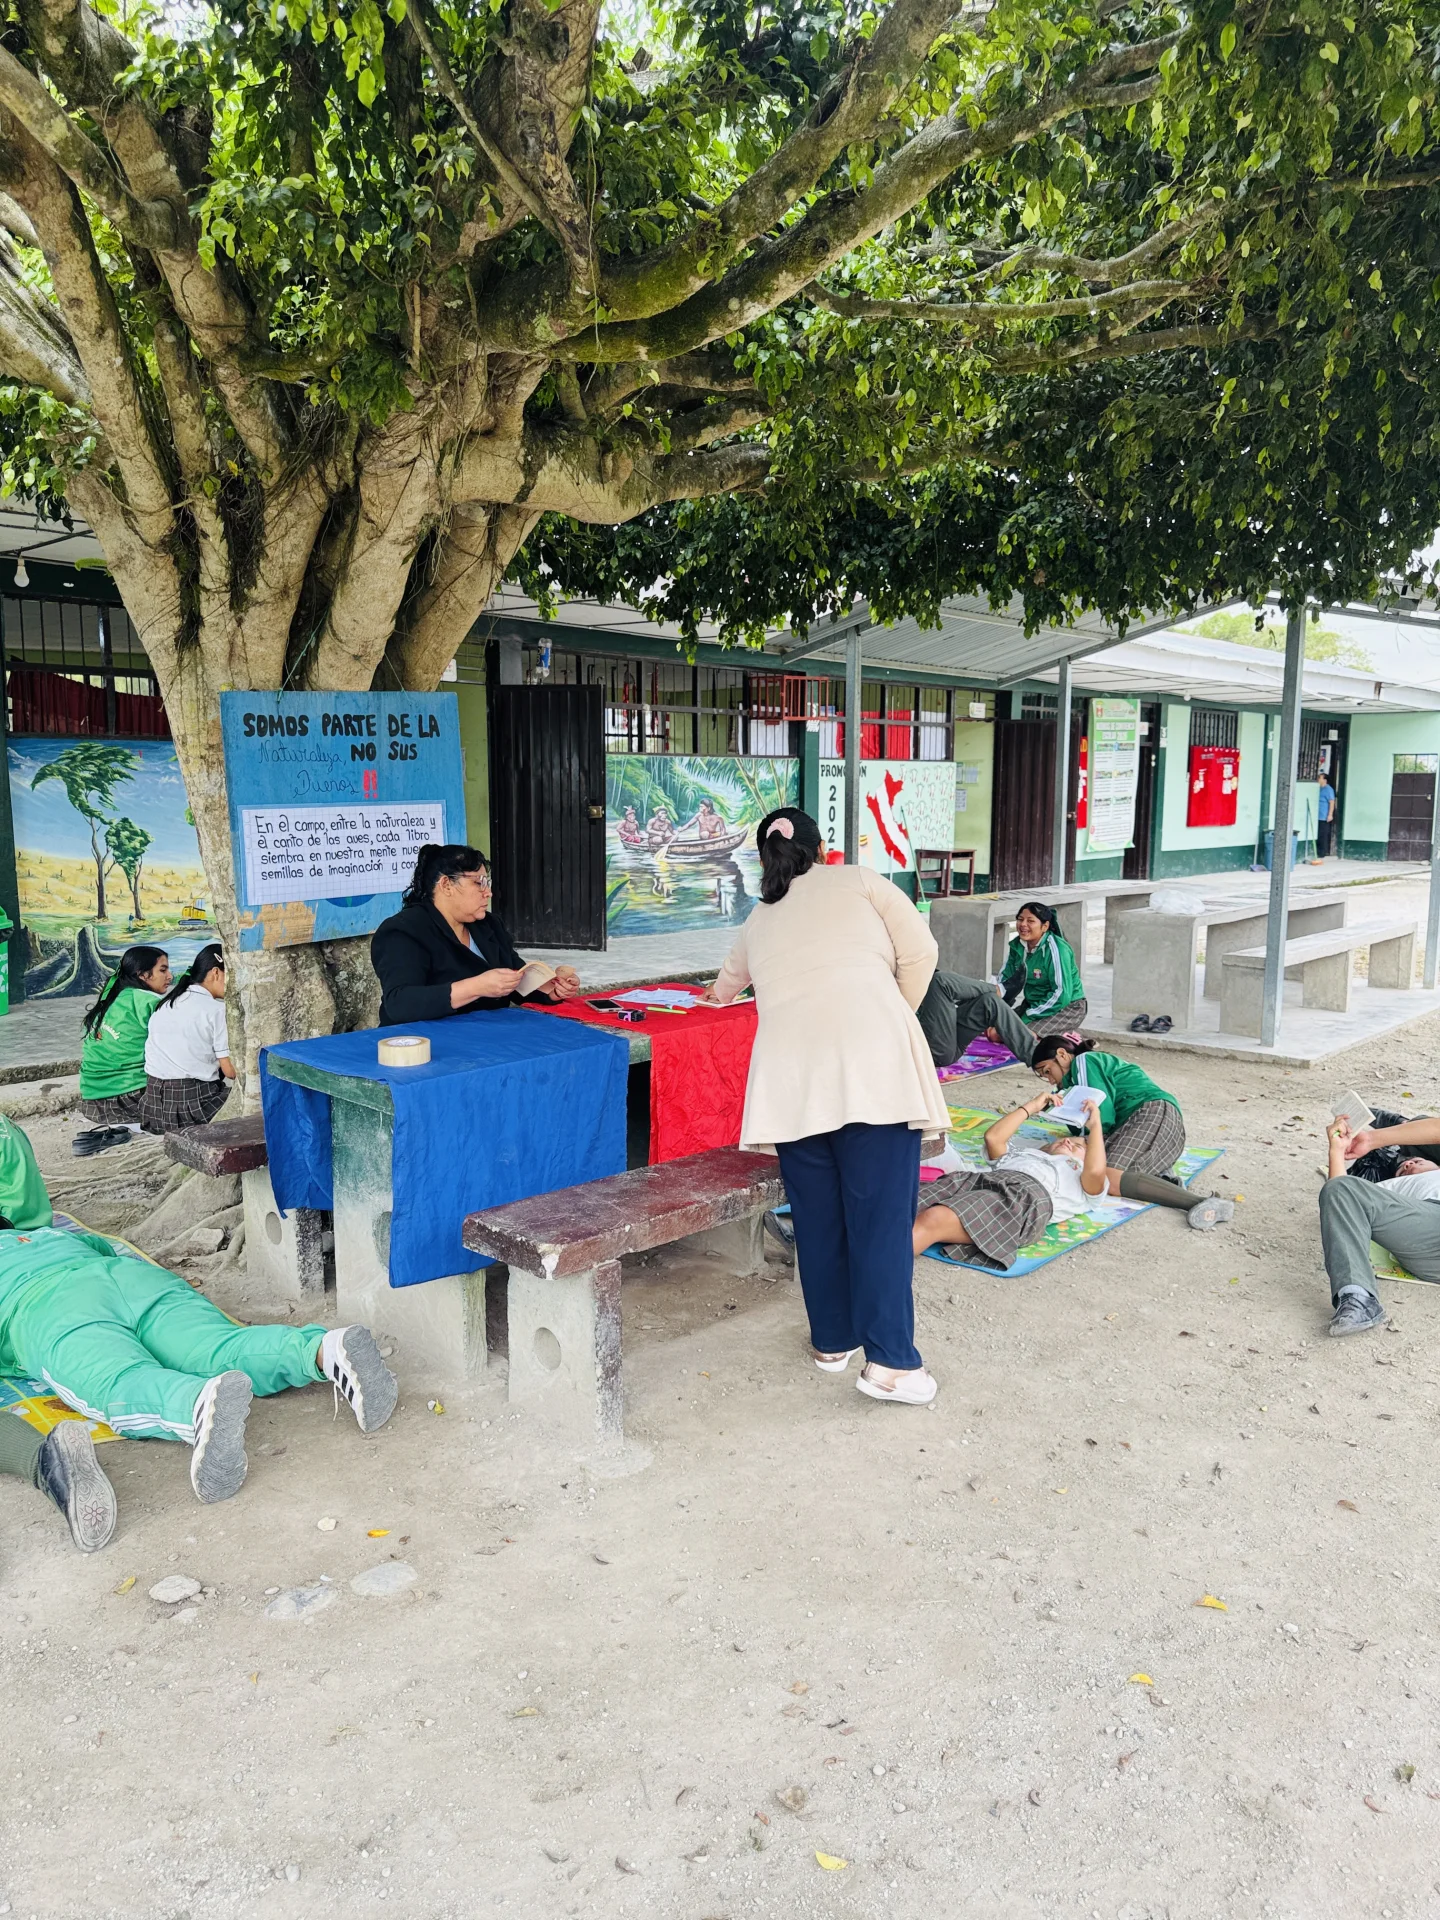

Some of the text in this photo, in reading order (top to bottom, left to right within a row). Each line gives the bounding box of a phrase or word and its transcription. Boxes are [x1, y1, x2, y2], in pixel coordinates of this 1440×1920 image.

[243, 713, 440, 738] SOMOS PARTE DE LA
[351, 742, 376, 761] NO
[388, 741, 417, 761] SUS
[820, 761, 867, 778] PROMN
[255, 812, 436, 834] En el campo, entre la naturaleza y
[257, 829, 430, 849] el canto de las aves, cada libro
[261, 848, 305, 864] siembra
[309, 852, 322, 861] en
[325, 846, 364, 861] nuestra
[370, 845, 397, 857] mente
[261, 865, 304, 880] semillas
[309, 864, 323, 877] de
[328, 859, 383, 877] imaginación
[392, 862, 398, 874] y
